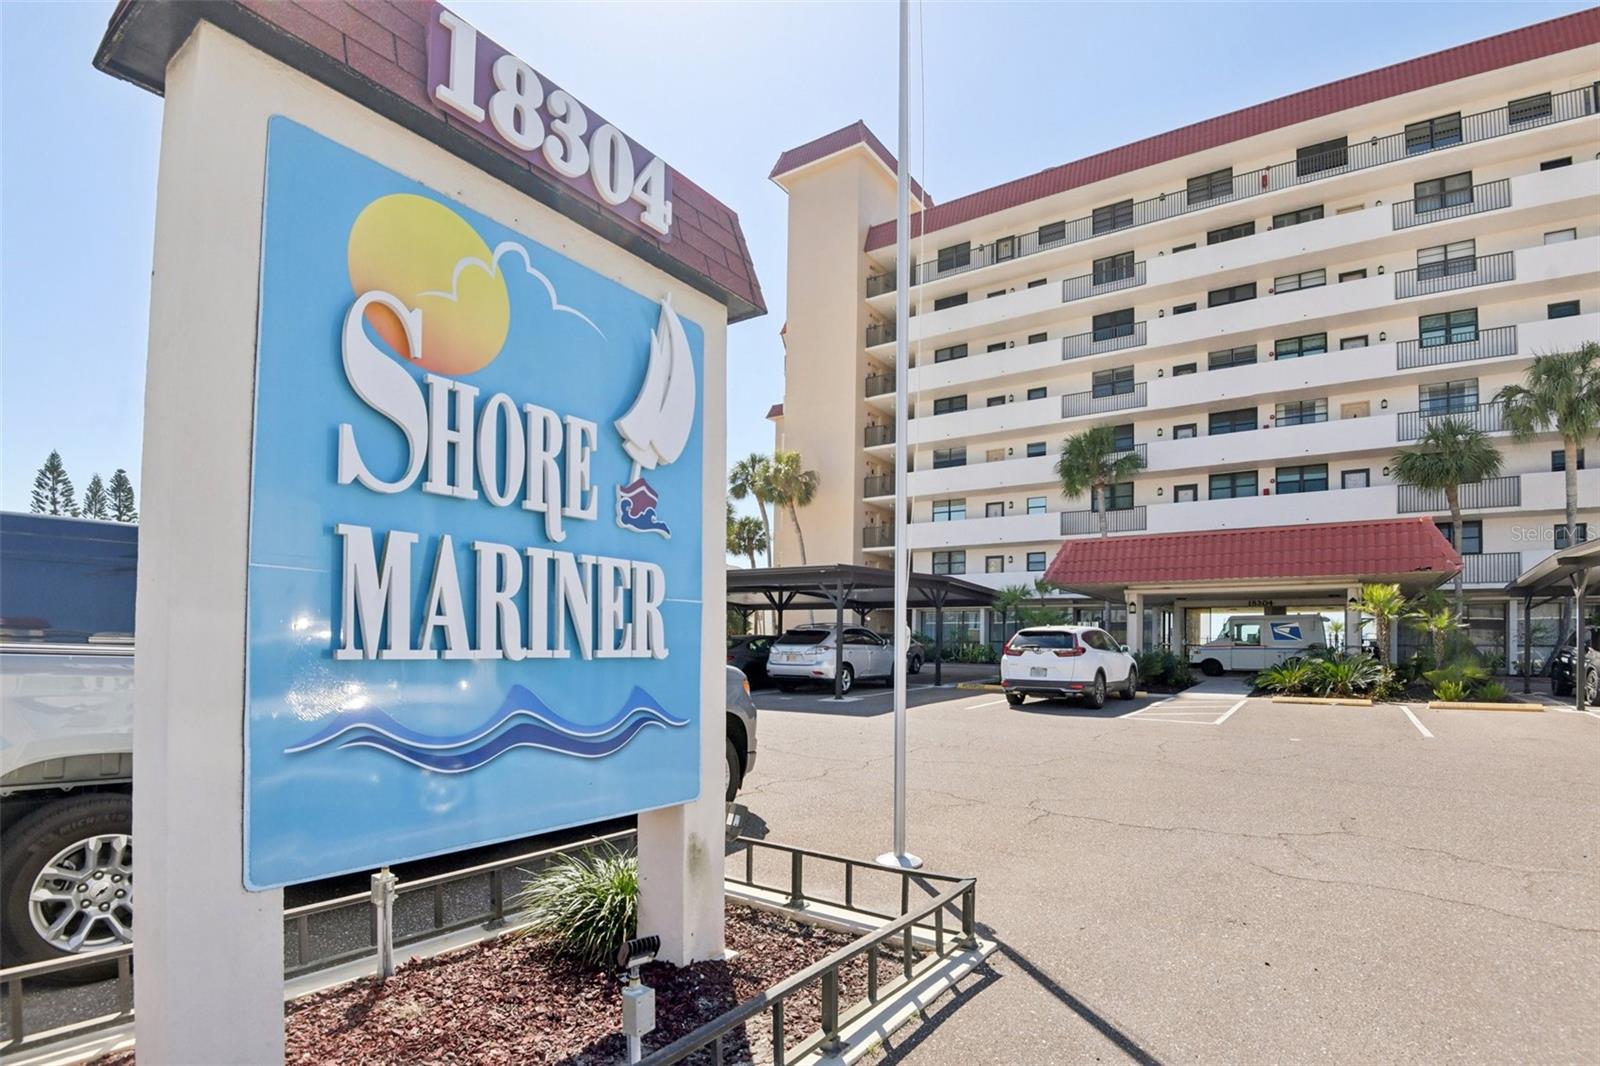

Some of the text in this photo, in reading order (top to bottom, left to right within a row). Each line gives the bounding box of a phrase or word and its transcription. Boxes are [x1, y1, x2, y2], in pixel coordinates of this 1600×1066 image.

[436, 10, 672, 235] 18304
[338, 290, 598, 543] SHORE
[335, 523, 669, 661] MARINER
